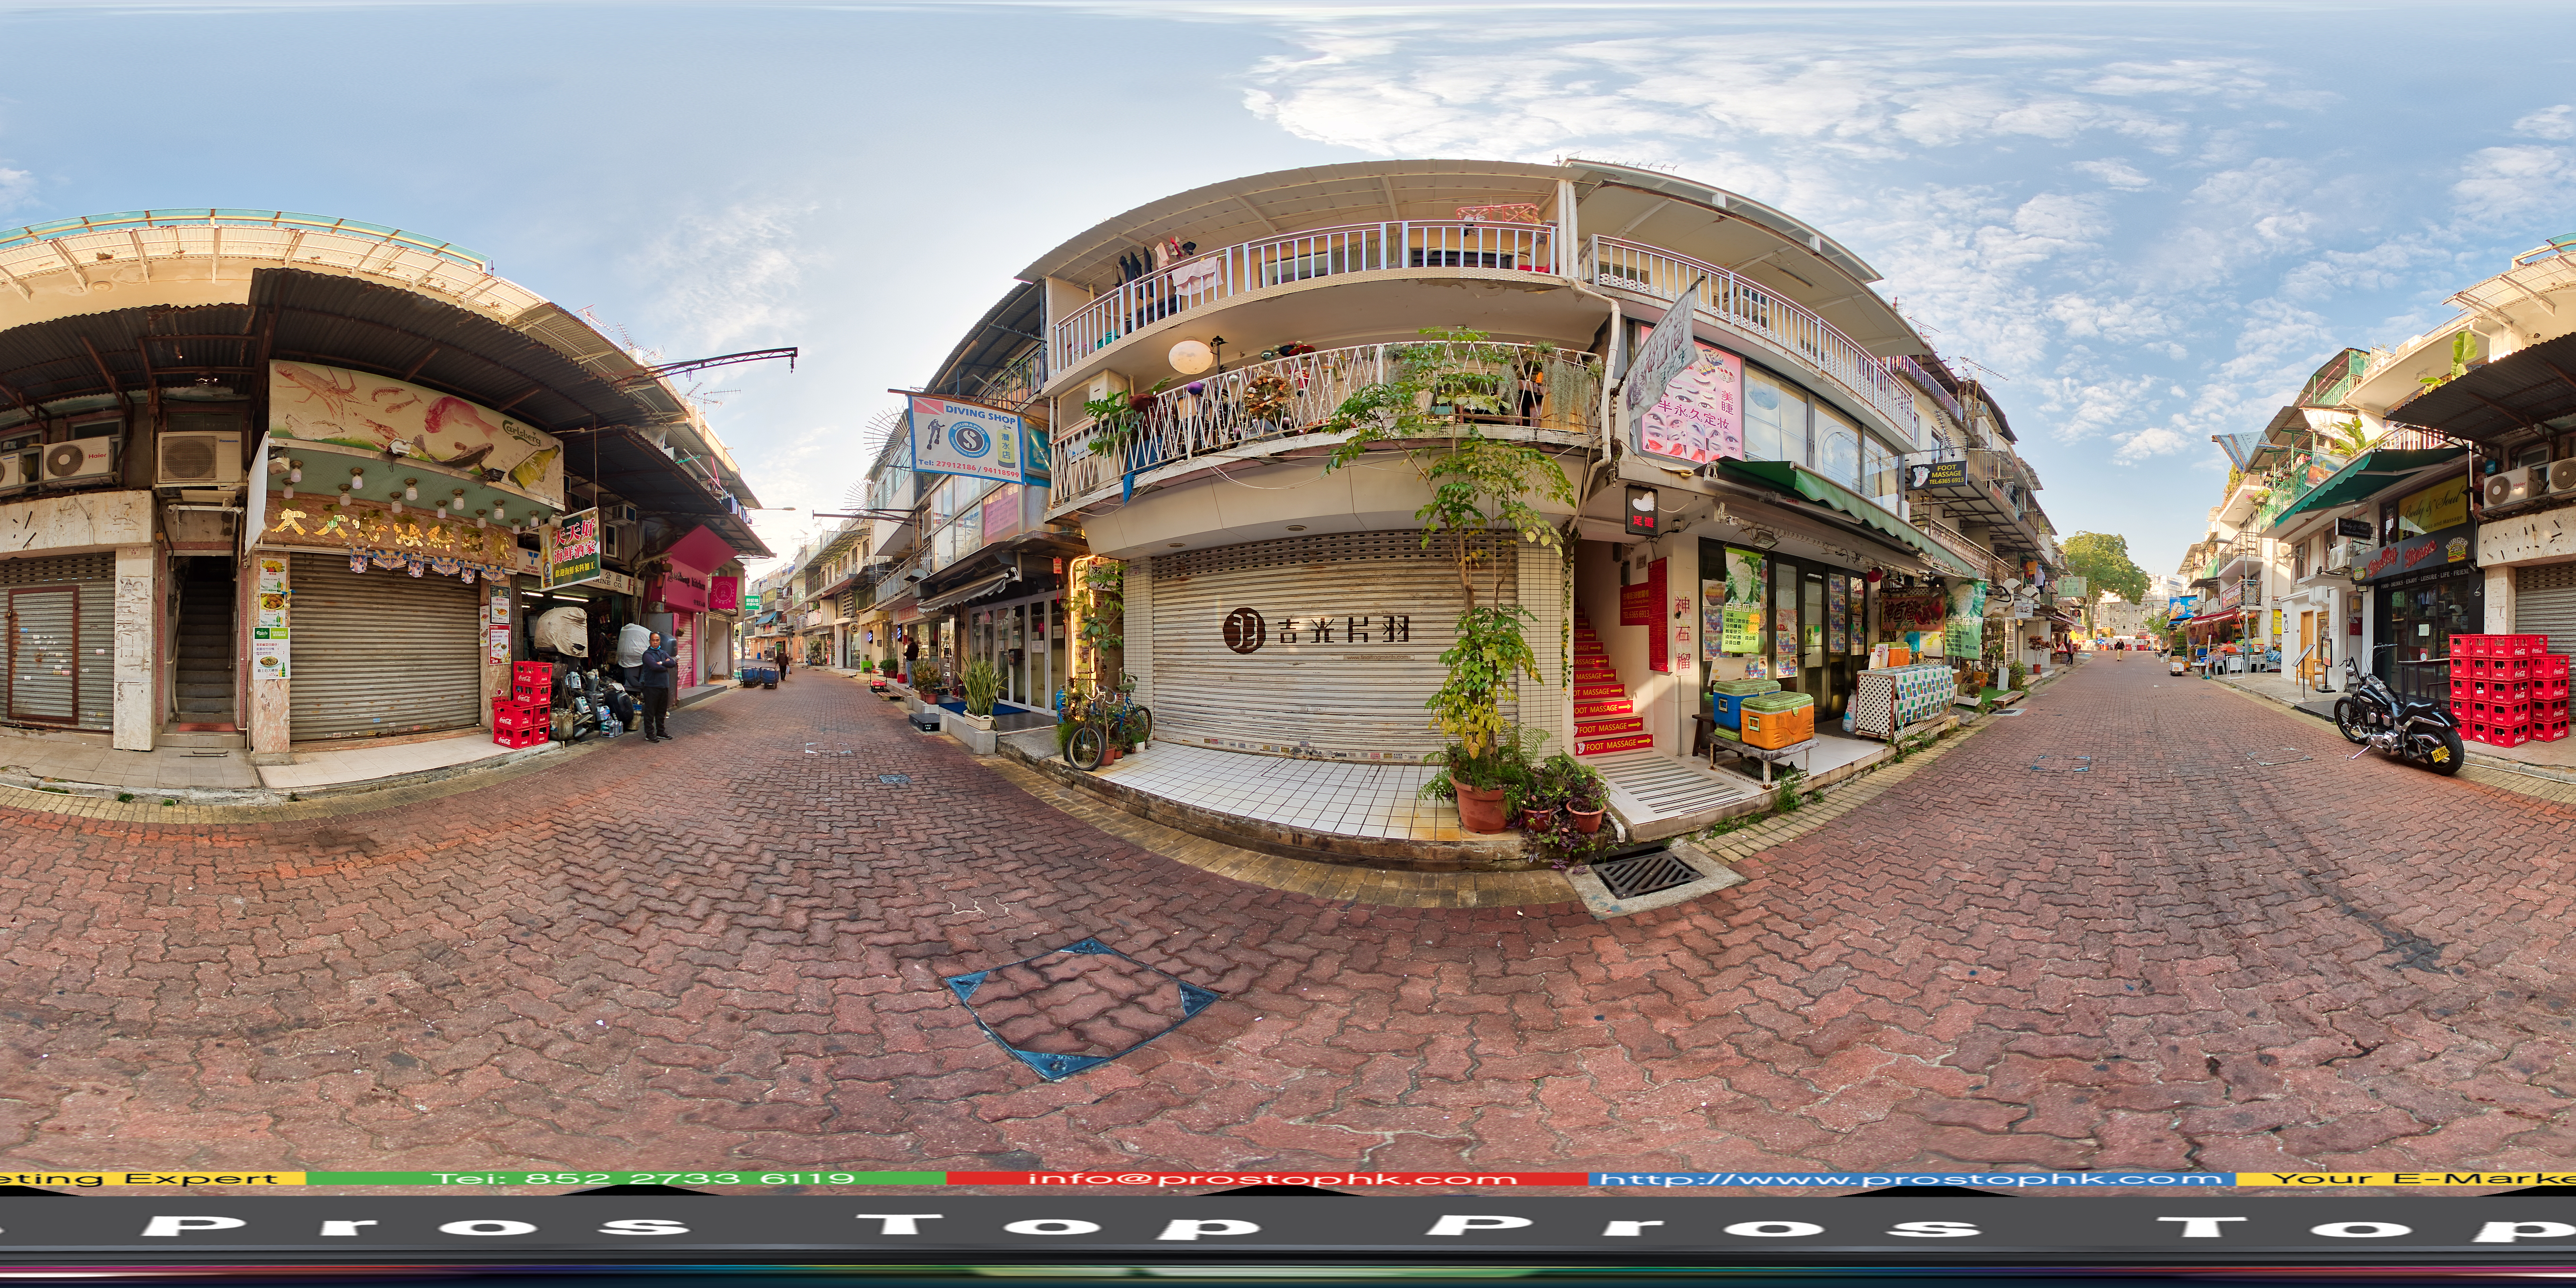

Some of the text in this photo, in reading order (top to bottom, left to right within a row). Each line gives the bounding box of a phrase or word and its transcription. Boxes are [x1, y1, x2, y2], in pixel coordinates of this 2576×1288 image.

[1721, 390, 1734, 415] 美睫
[946, 405, 1015, 424] DIVING SHOP
[1657, 399, 1730, 430] 半永久定妆
[502, 420, 541, 447] Carlsberg
[953, 422, 985, 435] SCUBAPRO
[950, 437, 968, 456] PROFESSIONAL
[979, 442, 989, 456] EQUIPMENT
[1001, 433, 1011, 459] 潛水店
[936, 461, 976, 471] 27912186
[983, 466, 1019, 478] 94118599
[1917, 471, 1925, 484] 足道
[1931, 470, 1962, 478] MASSAGE
[2403, 485, 2464, 526] Body & Soul
[1633, 515, 1654, 528] 足道
[2340, 521, 2353, 530] Body
[2422, 523, 2433, 531] Nails
[2443, 515, 2463, 526] Massage
[553, 517, 596, 549] 天天好
[2445, 536, 2469, 550] BURGER
[554, 540, 596, 564] 海鮮酒家
[2368, 539, 2437, 578] Bully Base
[555, 561, 595, 578] 歡迎海鮮來料加工
[605, 571, 622, 583] 公司
[692, 577, 706, 591] kitchen
[1623, 610, 1649, 619] TEL:6365 6913
[1725, 602, 1758, 613] 白苦瓜汁
[1883, 600, 1921, 622] 神石榴
[1277, 615, 1409, 643] 吉光片羽
[1675, 596, 1691, 670] 神石榴
[1894, 621, 1916, 630] 專門店
[1590, 704, 1618, 713] MASSAGE
[1579, 723, 1627, 734] FOOT MASSAGE
[1586, 739, 1636, 751] FOOT MASSAGE
[2439, 748, 2447, 757] 1755
